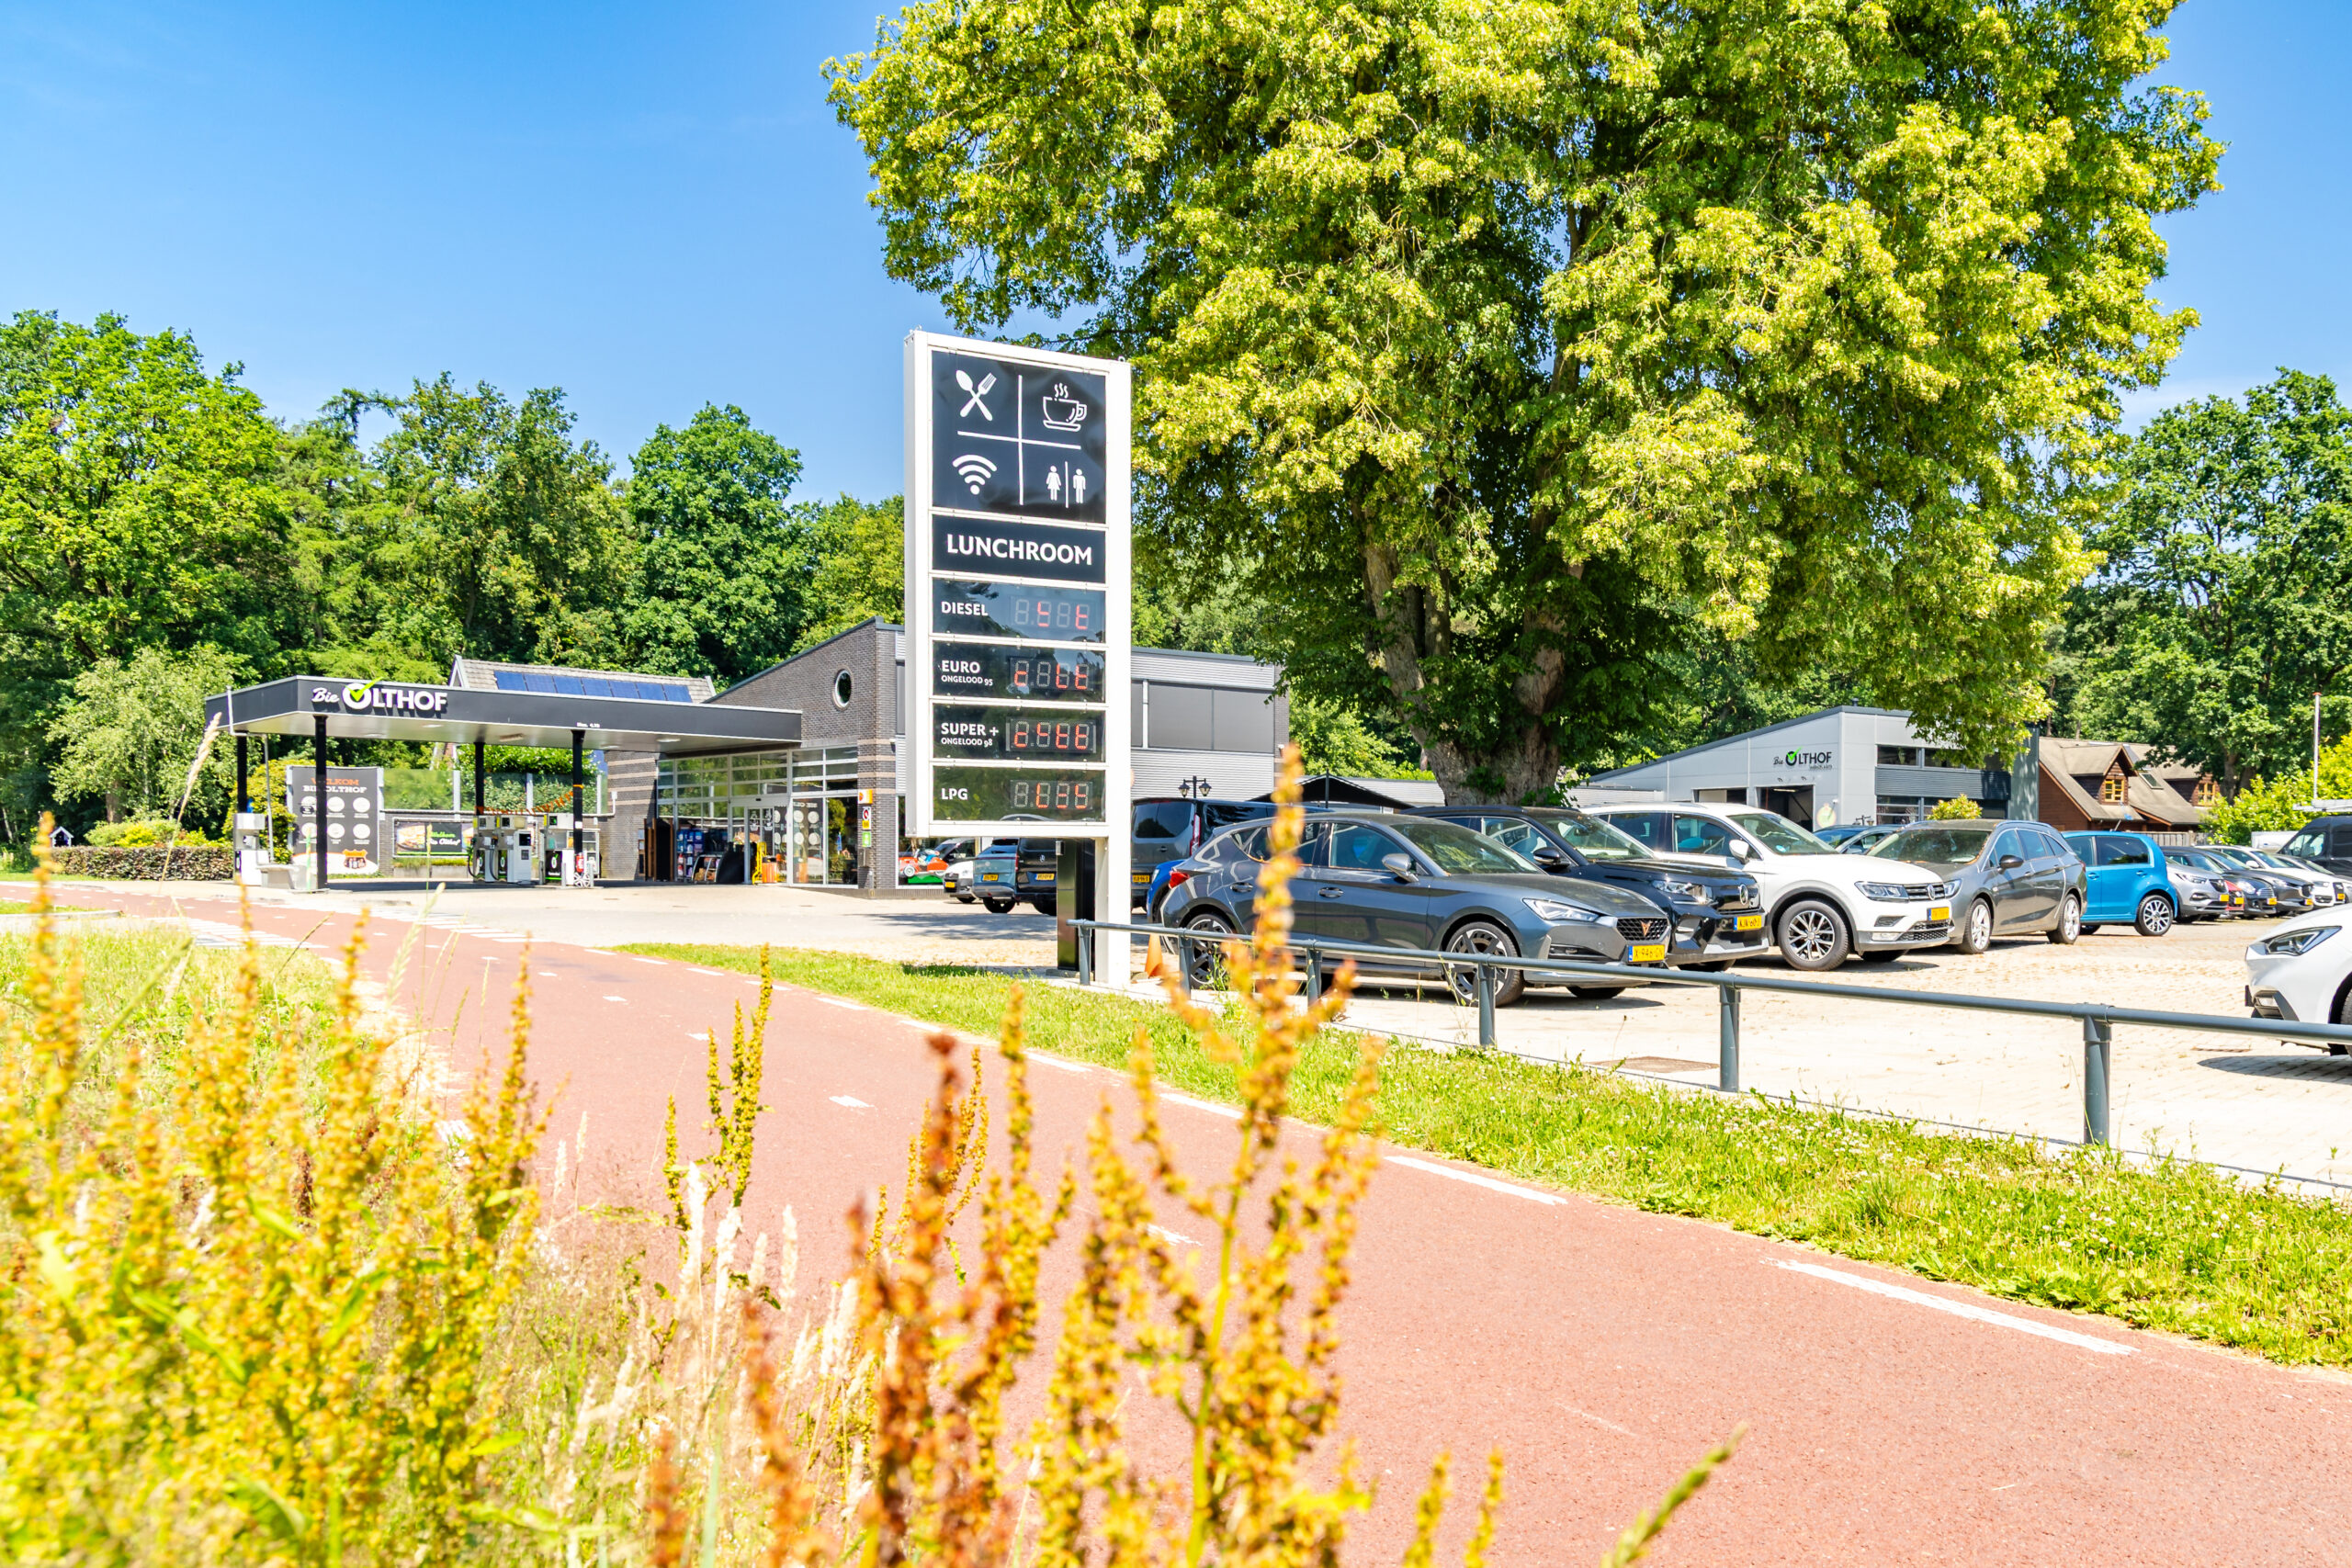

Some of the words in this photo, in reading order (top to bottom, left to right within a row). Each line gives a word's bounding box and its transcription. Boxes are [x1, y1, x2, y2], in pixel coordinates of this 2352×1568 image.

[947, 534, 1092, 566] LUNCHROOM
[941, 602, 989, 616] DIESEL
[942, 660, 981, 674] EURO
[941, 675, 983, 684] ONGELOOD
[984, 678, 993, 686] 95
[311, 687, 340, 703] Bie
[342, 682, 448, 712] OLTHOF
[941, 722, 987, 736] SUPER
[941, 738, 983, 747] ONGELOOD
[983, 739, 993, 748] 98
[1773, 756, 1784, 765] Bie
[1785, 750, 1833, 766] OLTHOF
[941, 788, 968, 800] LPG
